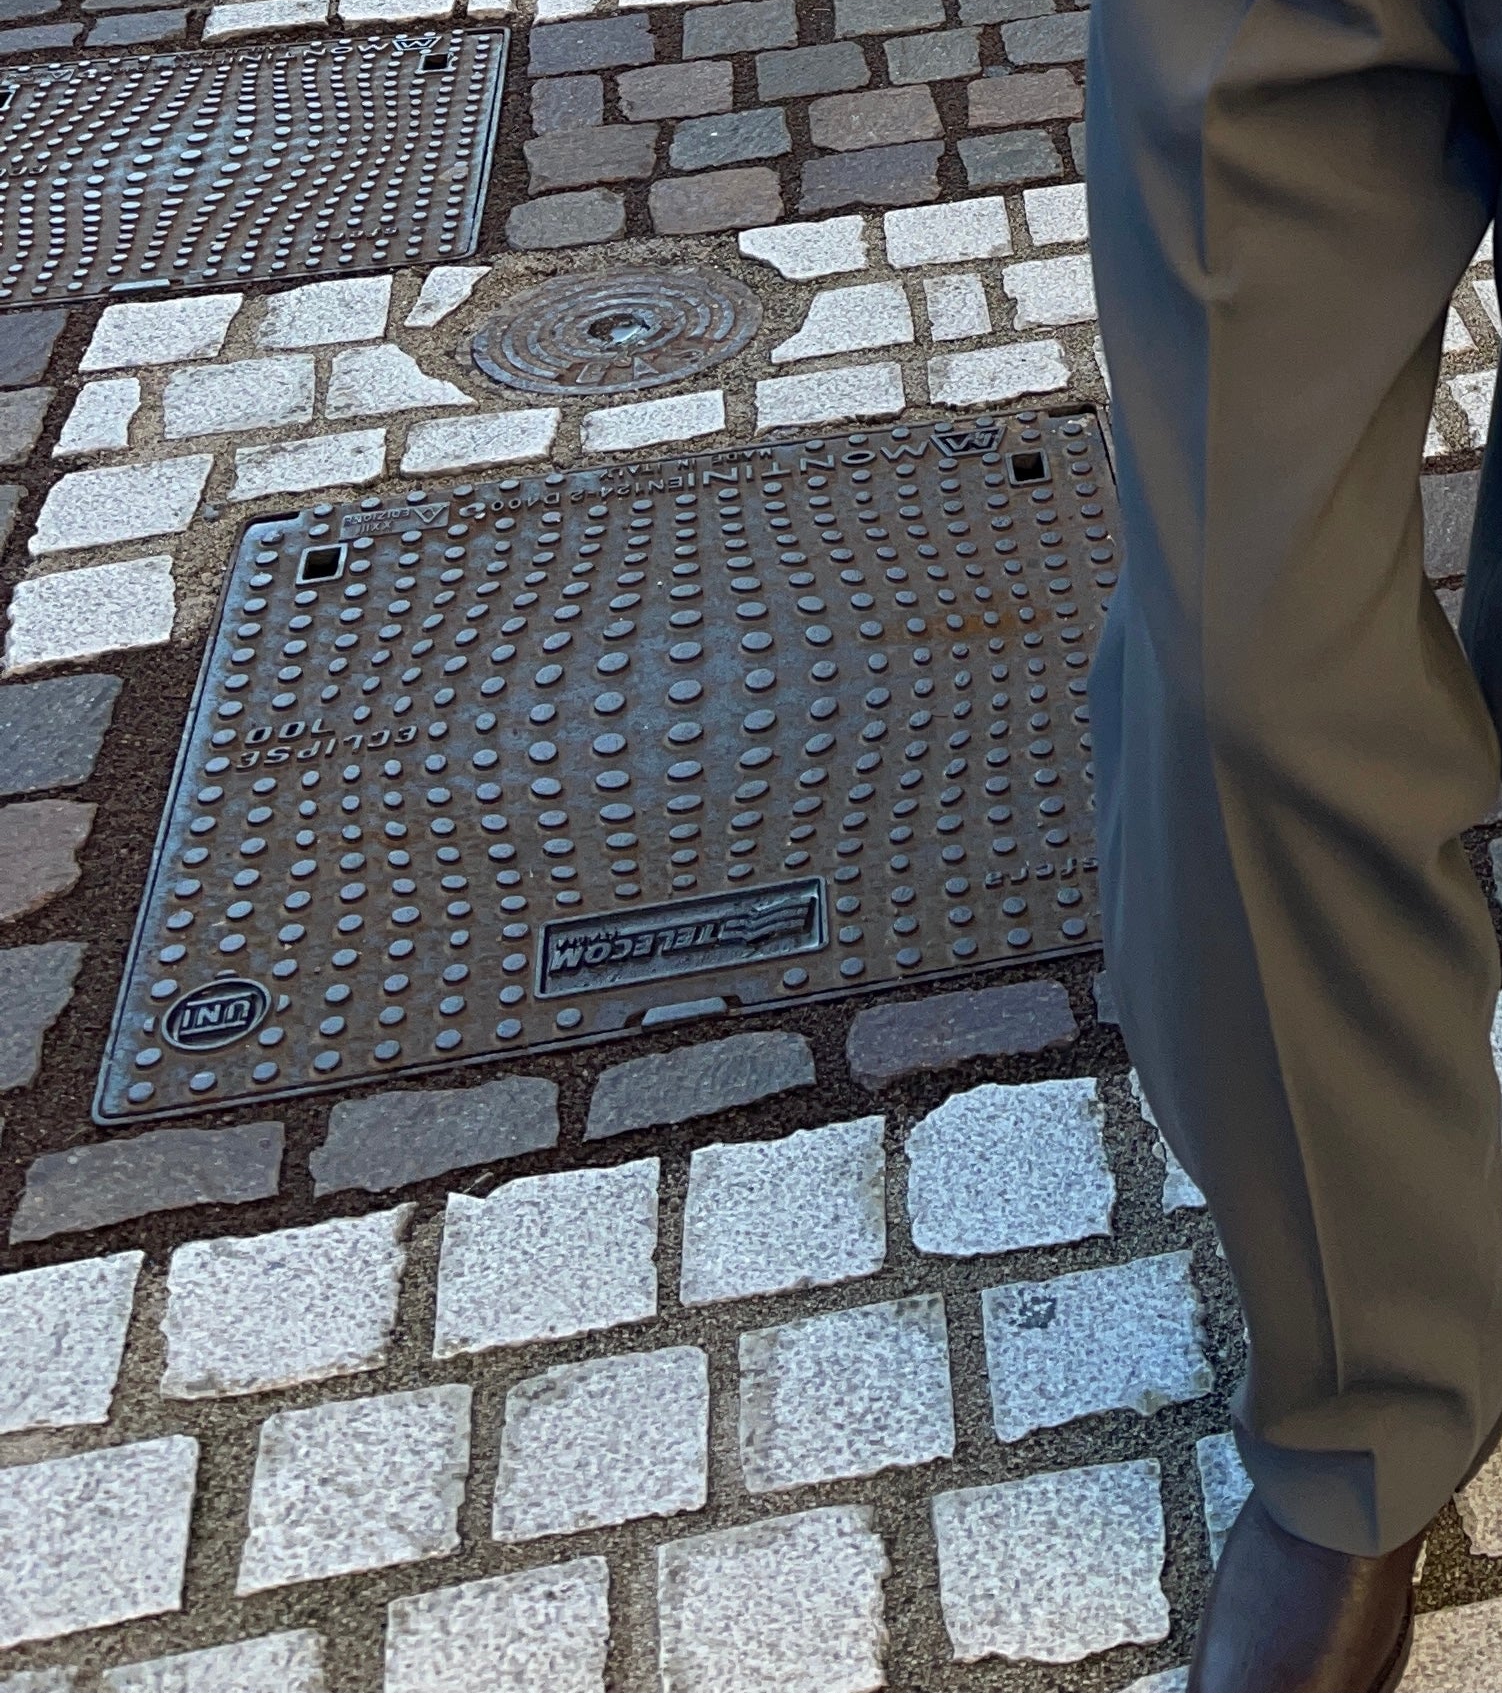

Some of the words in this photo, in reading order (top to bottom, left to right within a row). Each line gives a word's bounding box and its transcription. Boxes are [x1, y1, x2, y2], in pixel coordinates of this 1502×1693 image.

[687, 440, 926, 487] MONTINI
[235, 725, 418, 769] ECLIPSE
[245, 719, 335, 744] 700
[550, 924, 714, 972] TELECOM
[182, 1000, 251, 1028] UNI
